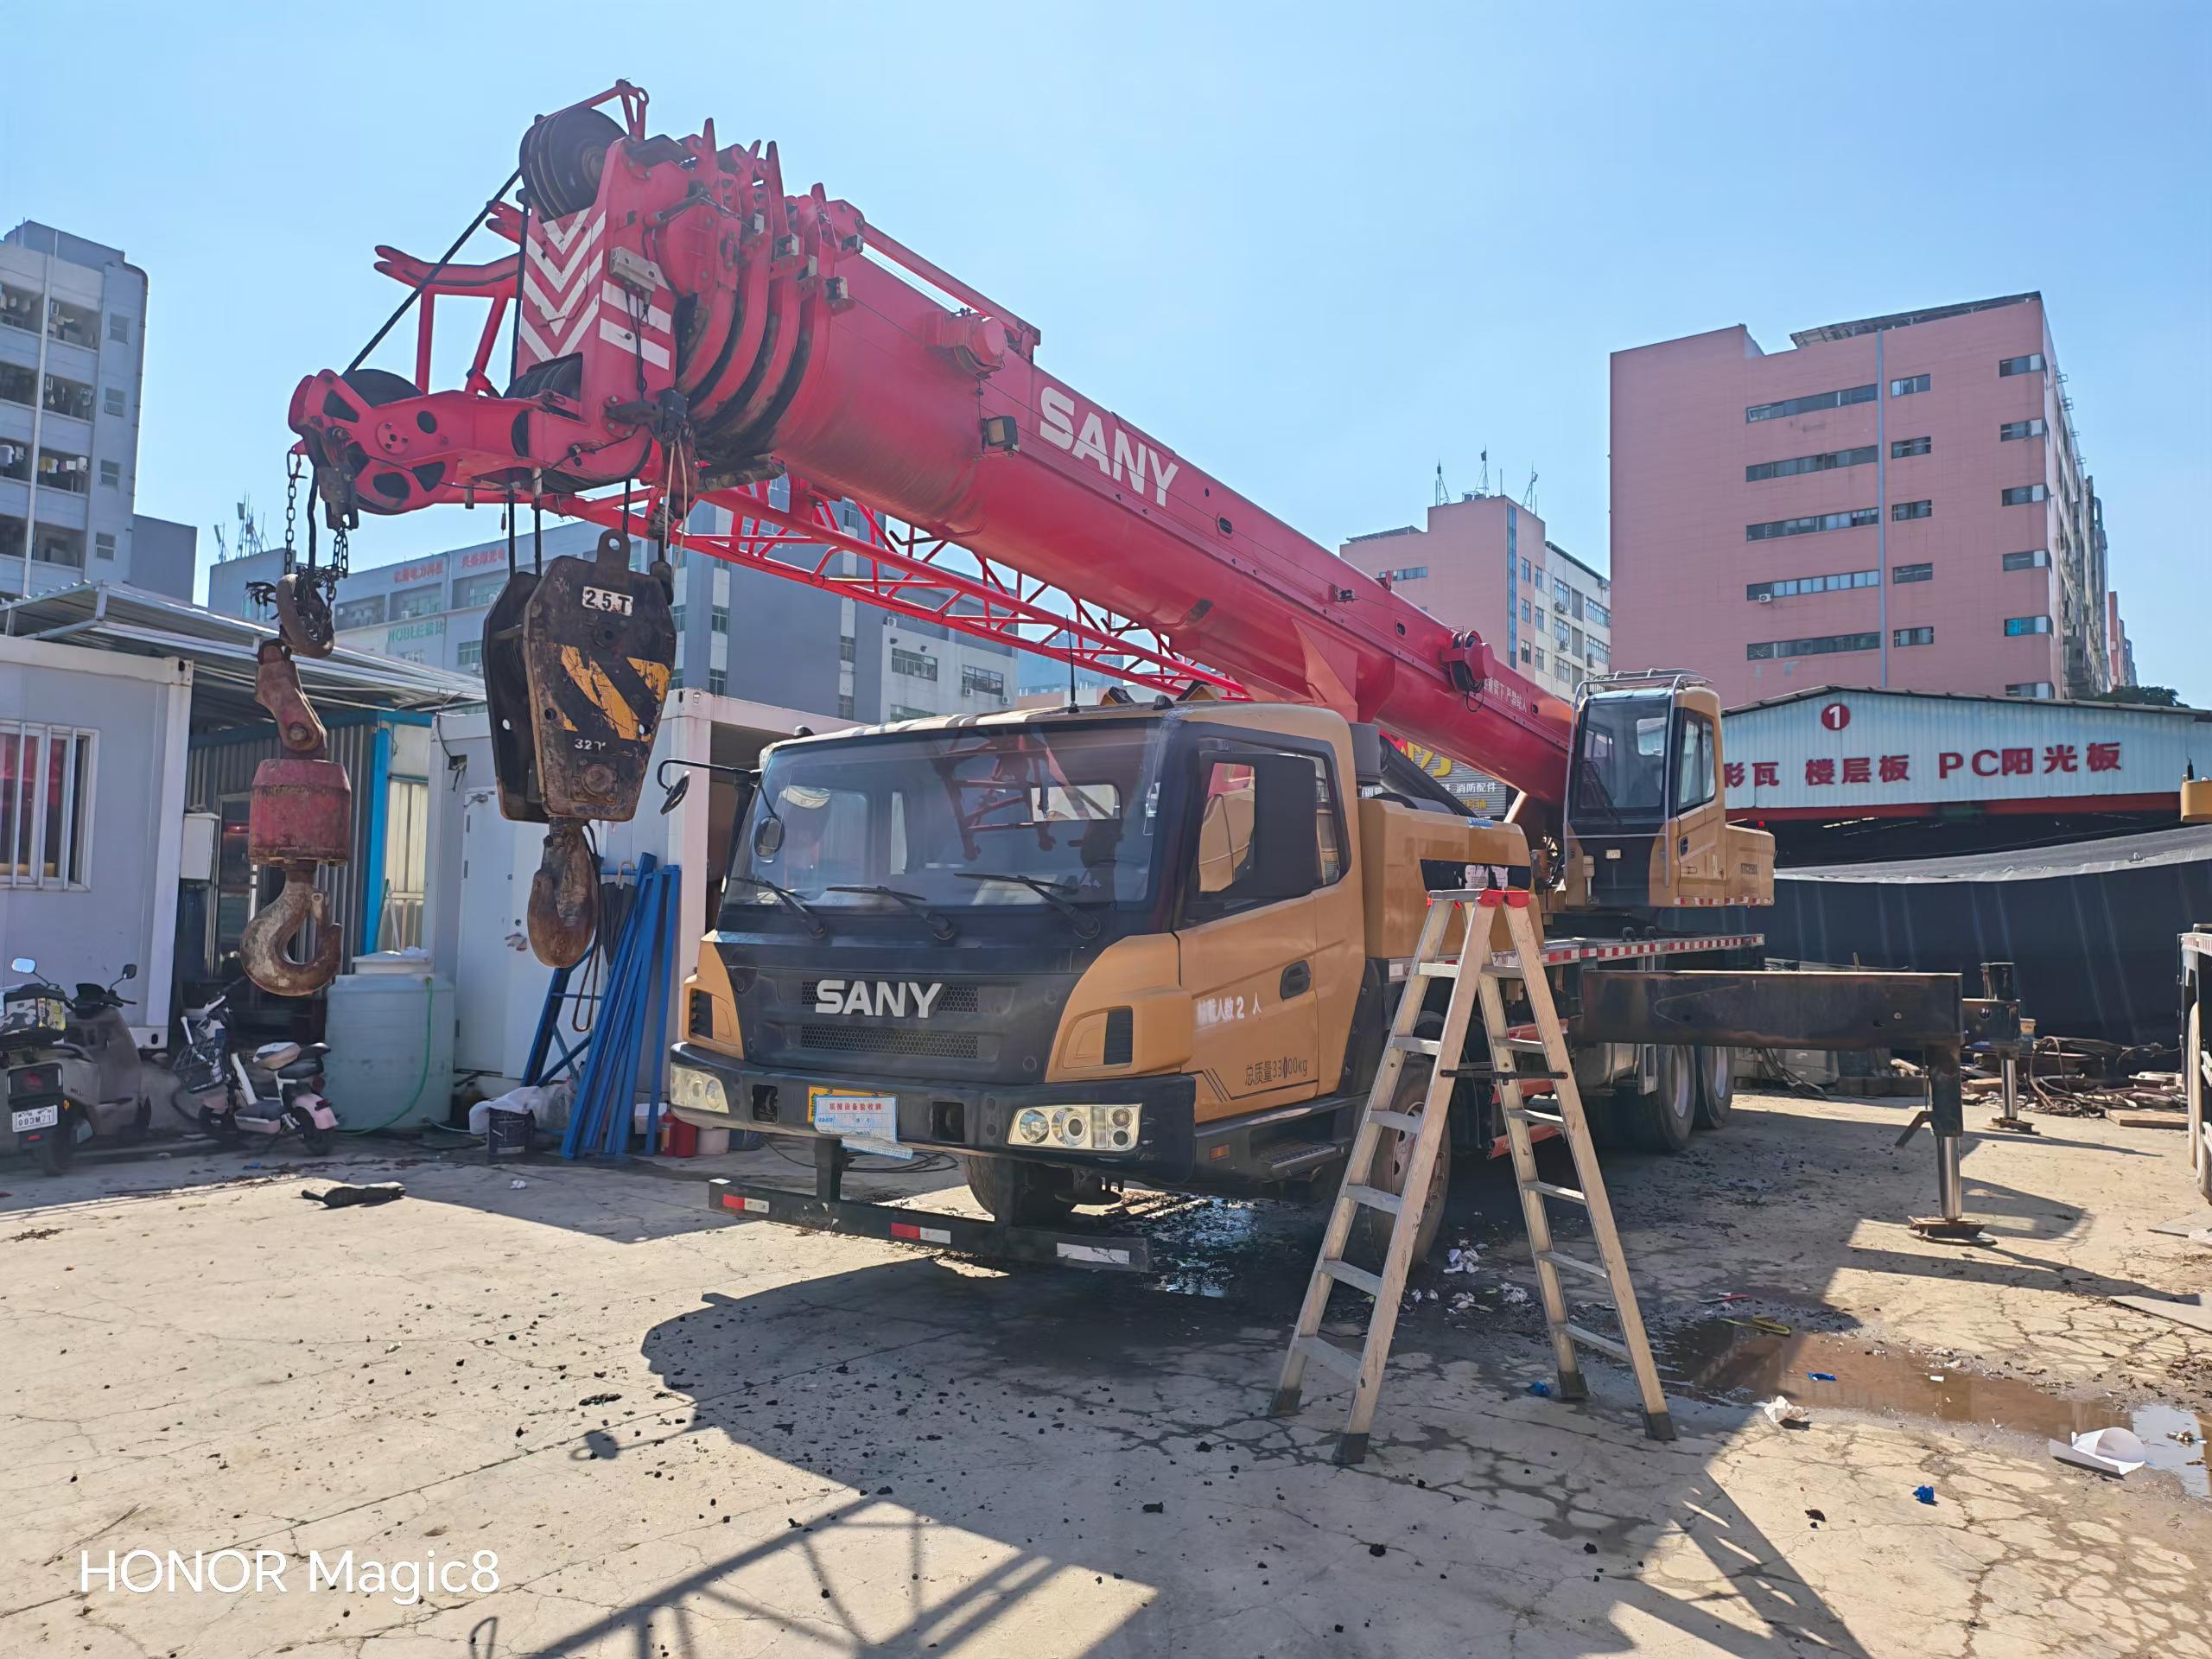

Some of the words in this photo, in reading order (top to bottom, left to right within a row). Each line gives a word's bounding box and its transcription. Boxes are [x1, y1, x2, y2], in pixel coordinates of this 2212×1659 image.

[1039, 386, 1179, 507] SANY
[585, 589, 632, 614] 25T
[1805, 754, 1911, 786] 楼层板
[1939, 742, 2122, 779] PC阳光板
[1455, 781, 1497, 794] 消防配件
[815, 979, 944, 1019] SANY
[1236, 995, 1245, 1019] 2
[1252, 992, 1262, 1015] 人
